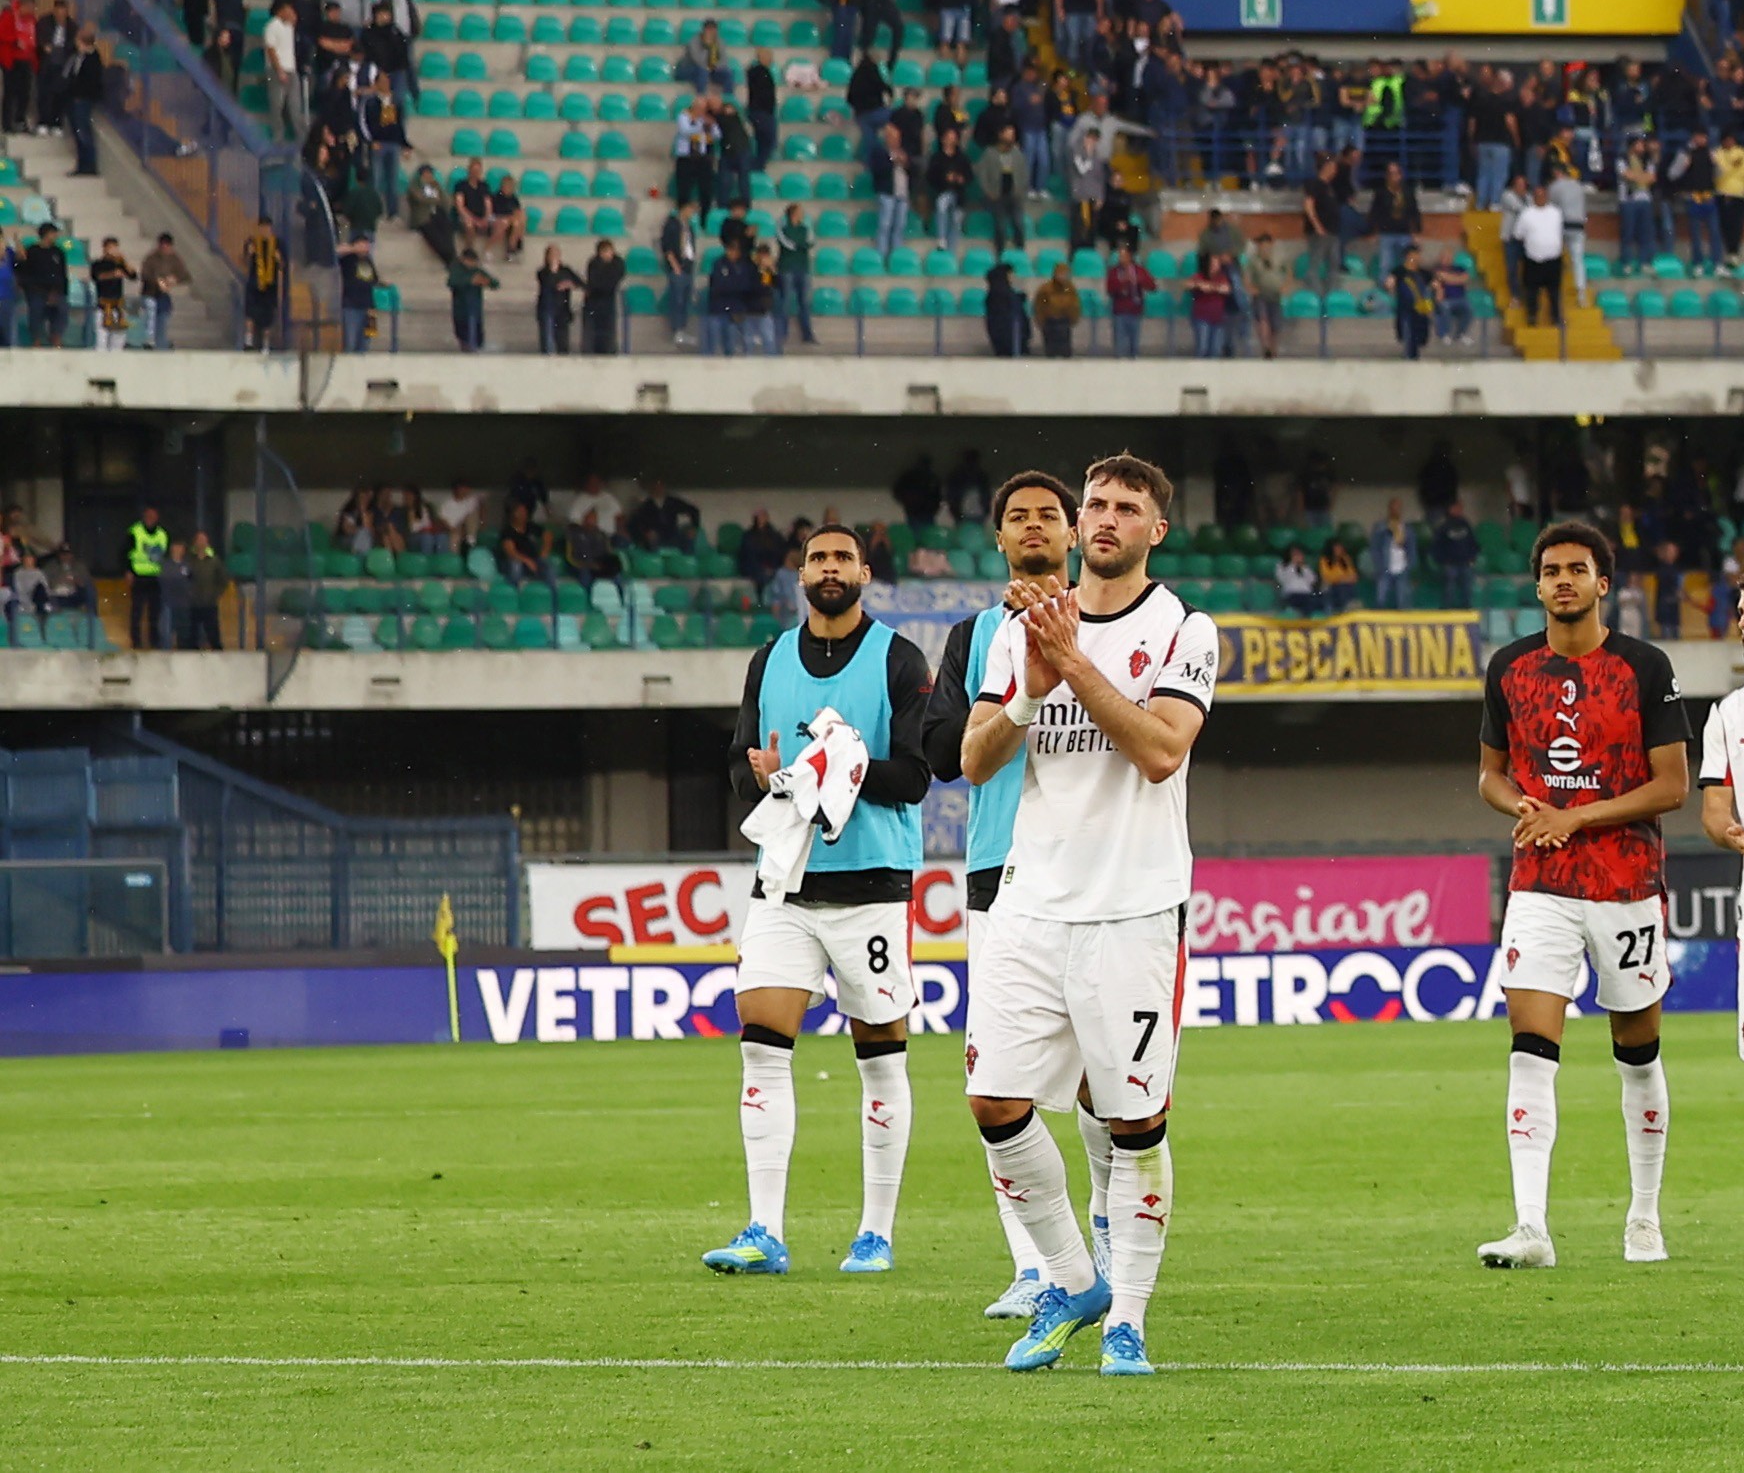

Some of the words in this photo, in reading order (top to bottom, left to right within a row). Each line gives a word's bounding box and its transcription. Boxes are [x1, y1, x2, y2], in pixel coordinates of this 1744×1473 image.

[1241, 625, 1476, 682] PESCANTINA
[1180, 662, 1212, 691] MS
[1037, 730, 1061, 755] FLY
[1541, 774, 1601, 789] OOTBALL
[867, 935, 889, 974] 8
[1616, 924, 1657, 970] 27
[1131, 1010, 1159, 1062] 7
